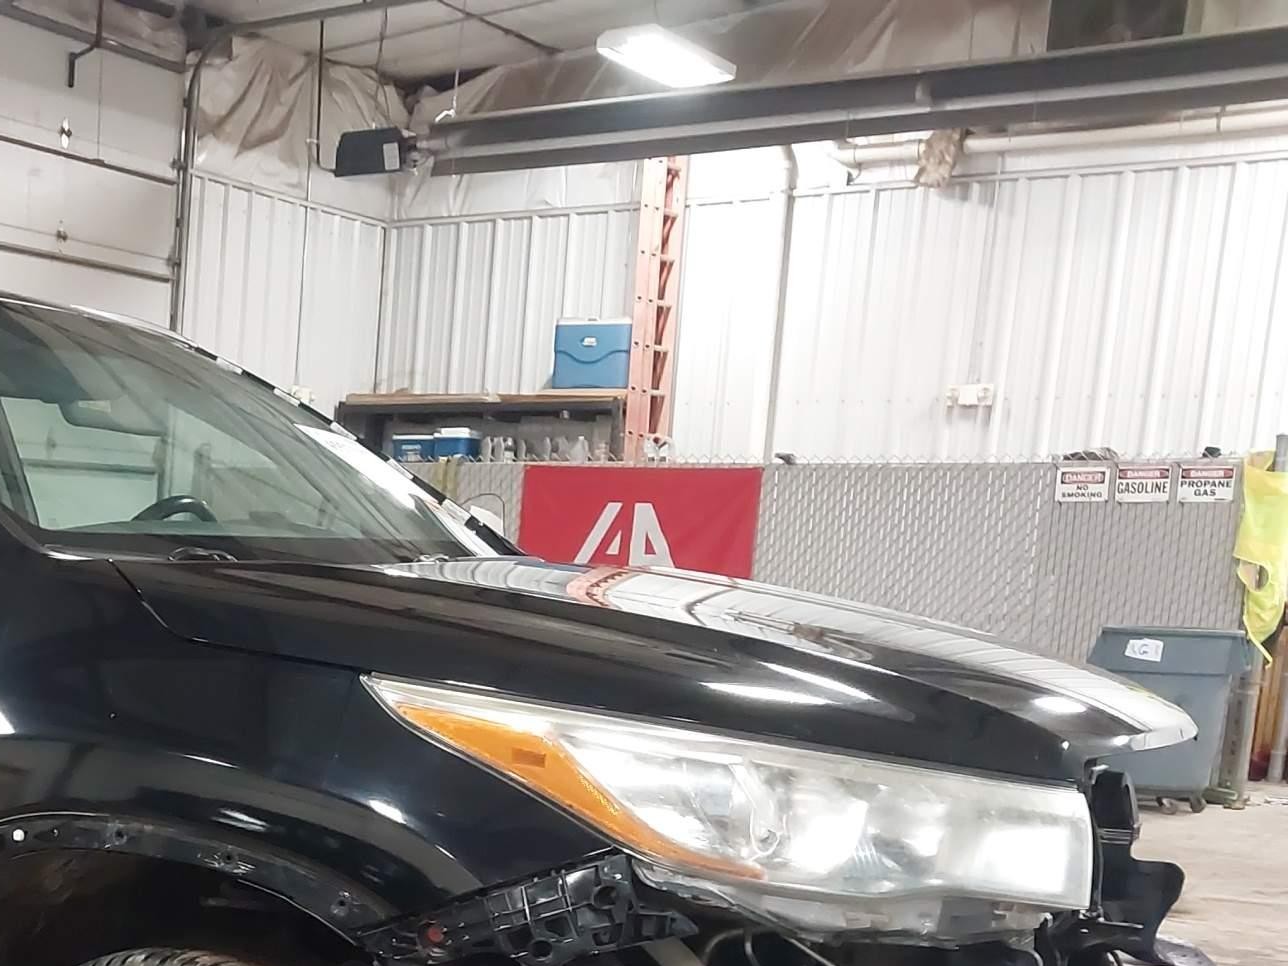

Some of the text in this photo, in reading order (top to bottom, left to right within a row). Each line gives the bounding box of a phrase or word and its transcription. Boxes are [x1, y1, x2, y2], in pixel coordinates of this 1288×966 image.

[1117, 481, 1168, 495] GASOLINE
[1180, 480, 1232, 488] PROPANE
[1194, 489, 1217, 497] GAS
